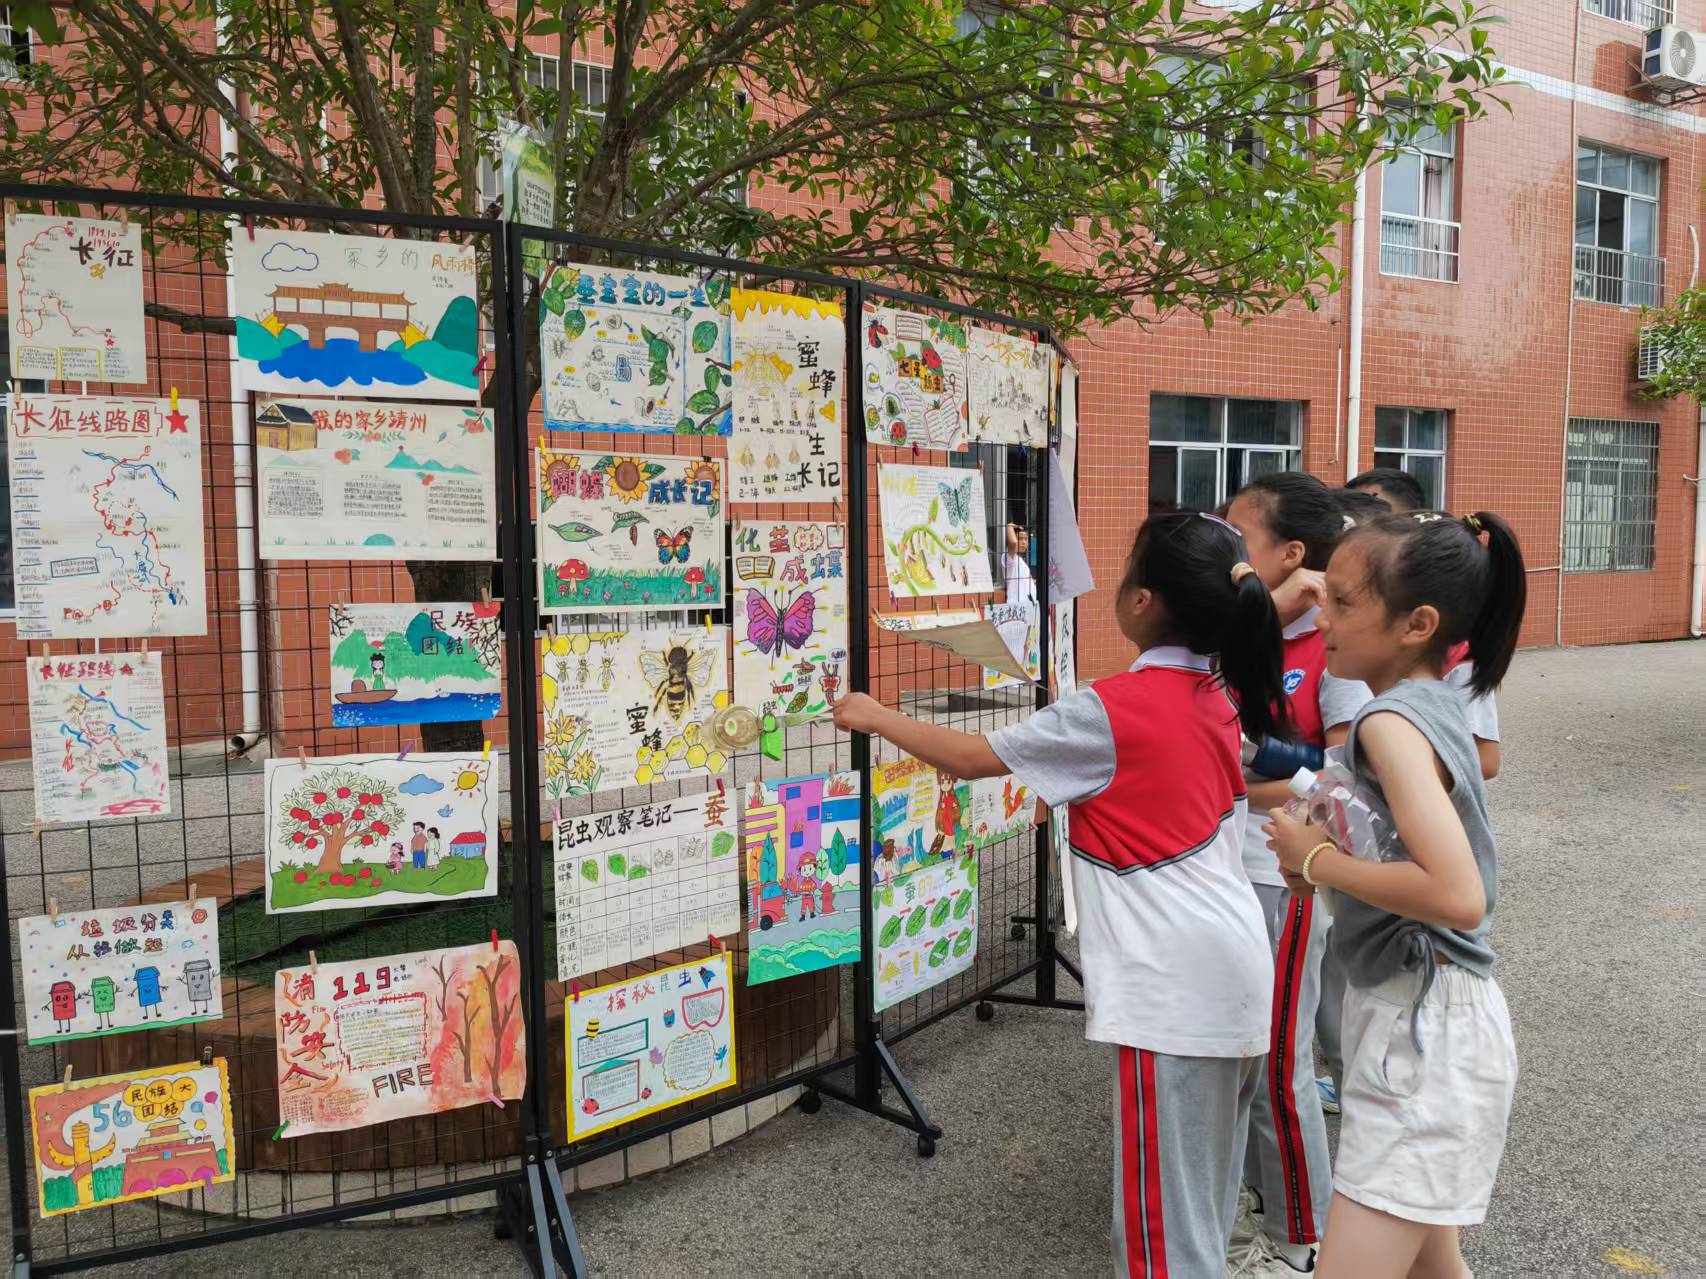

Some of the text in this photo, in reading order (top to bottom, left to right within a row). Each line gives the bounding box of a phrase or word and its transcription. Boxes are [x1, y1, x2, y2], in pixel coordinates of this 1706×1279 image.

[70, 236, 134, 267] 长征
[344, 245, 419, 270] 家乡的
[16, 401, 151, 434] 长征线路图
[312, 408, 429, 434] 我的家乡靖州
[551, 469, 604, 500] 蝴蝶
[648, 479, 714, 506] 成长记
[780, 550, 844, 584] 成蝶
[430, 610, 479, 632] 民族
[626, 702, 662, 751] 蜜蜂
[81, 909, 177, 938] 垃圾分类
[67, 937, 163, 960] 从我做起
[332, 966, 391, 1001] 119
[607, 969, 691, 1012] 探秘昆虫
[279, 972, 335, 1093] 消防安全
[131, 1083, 192, 1102] 民族大
[372, 1063, 434, 1098] FIRE
[93, 1100, 133, 1133] 56
